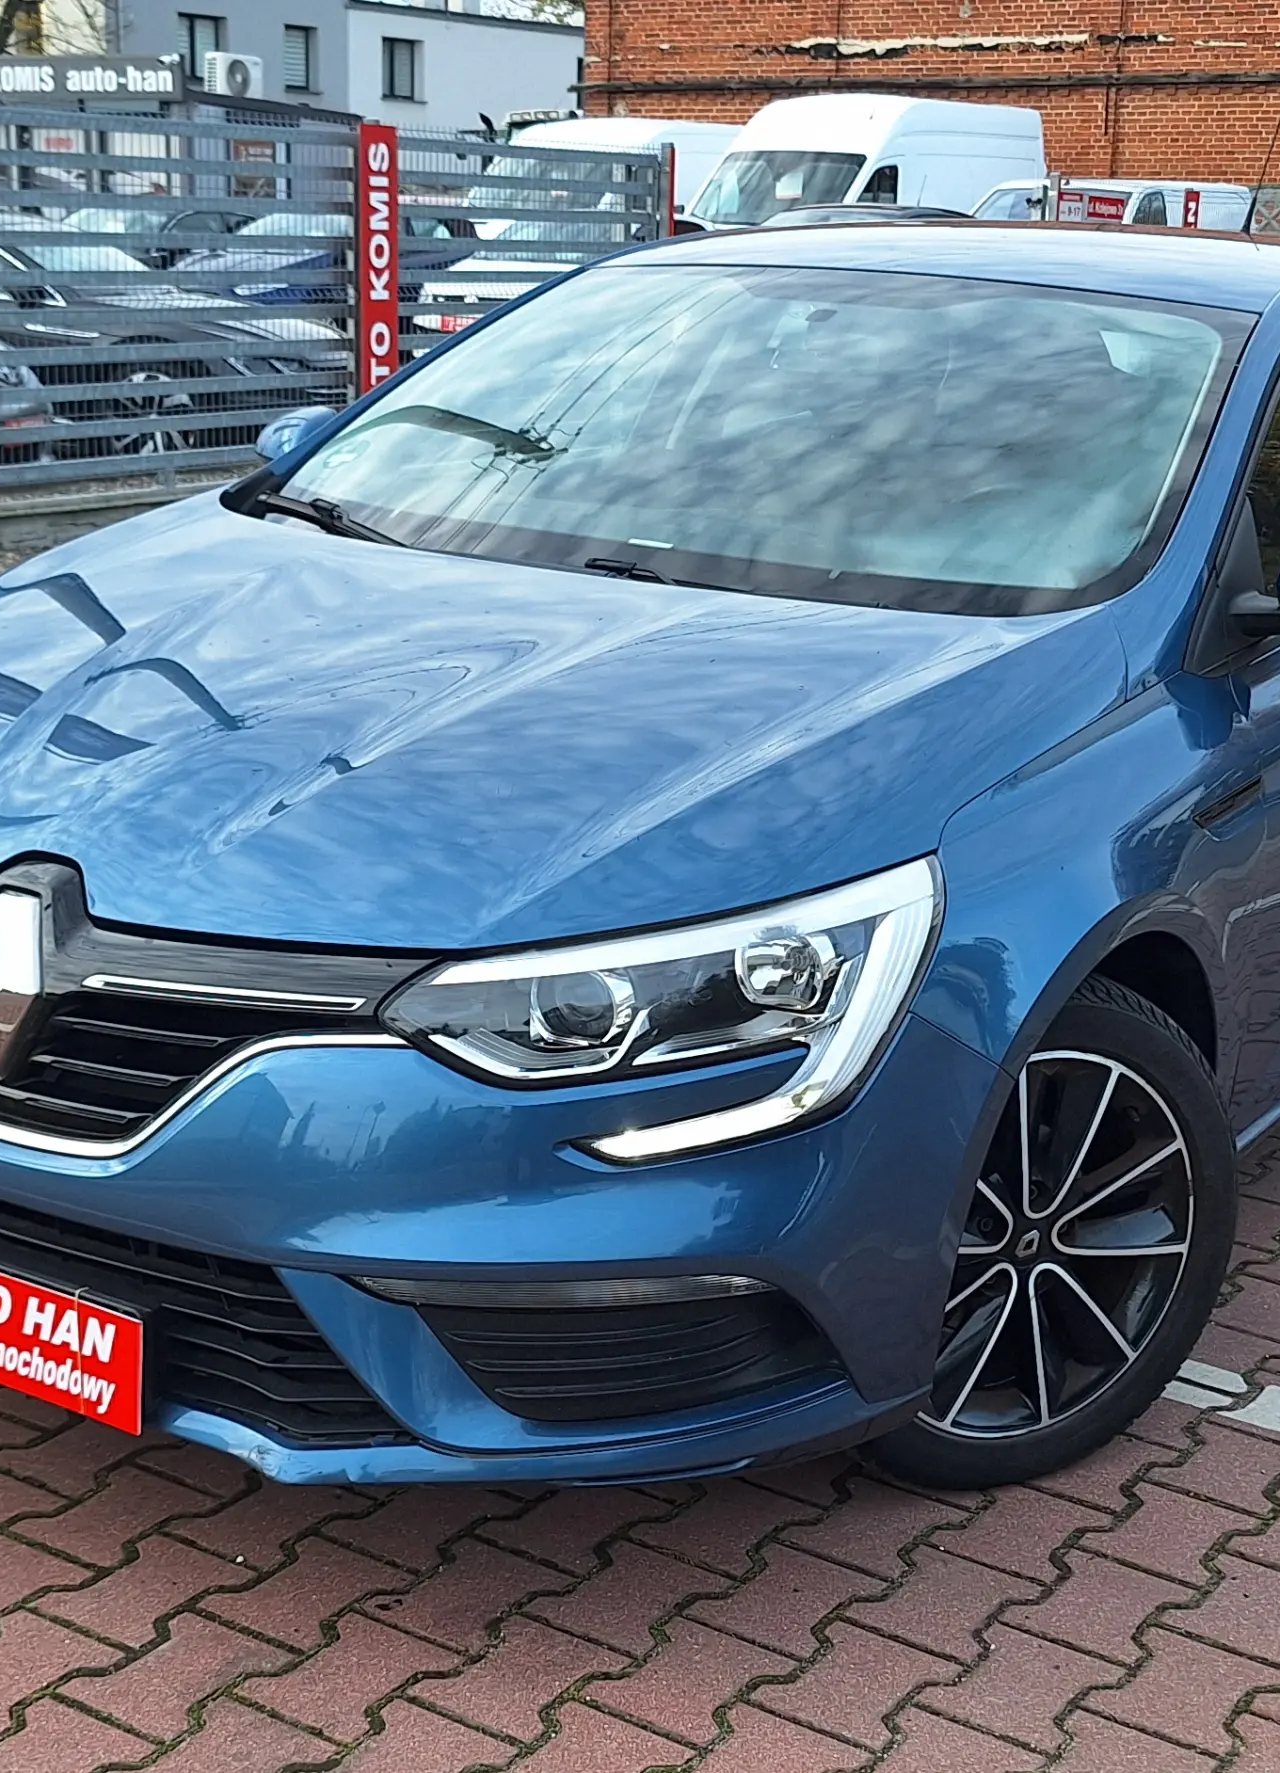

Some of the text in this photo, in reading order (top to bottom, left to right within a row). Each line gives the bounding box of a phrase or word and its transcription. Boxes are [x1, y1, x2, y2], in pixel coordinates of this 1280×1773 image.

[65, 65, 174, 93] auto-han
[367, 142, 392, 386] TO KOMIS
[22, 1295, 117, 1364] HAN
